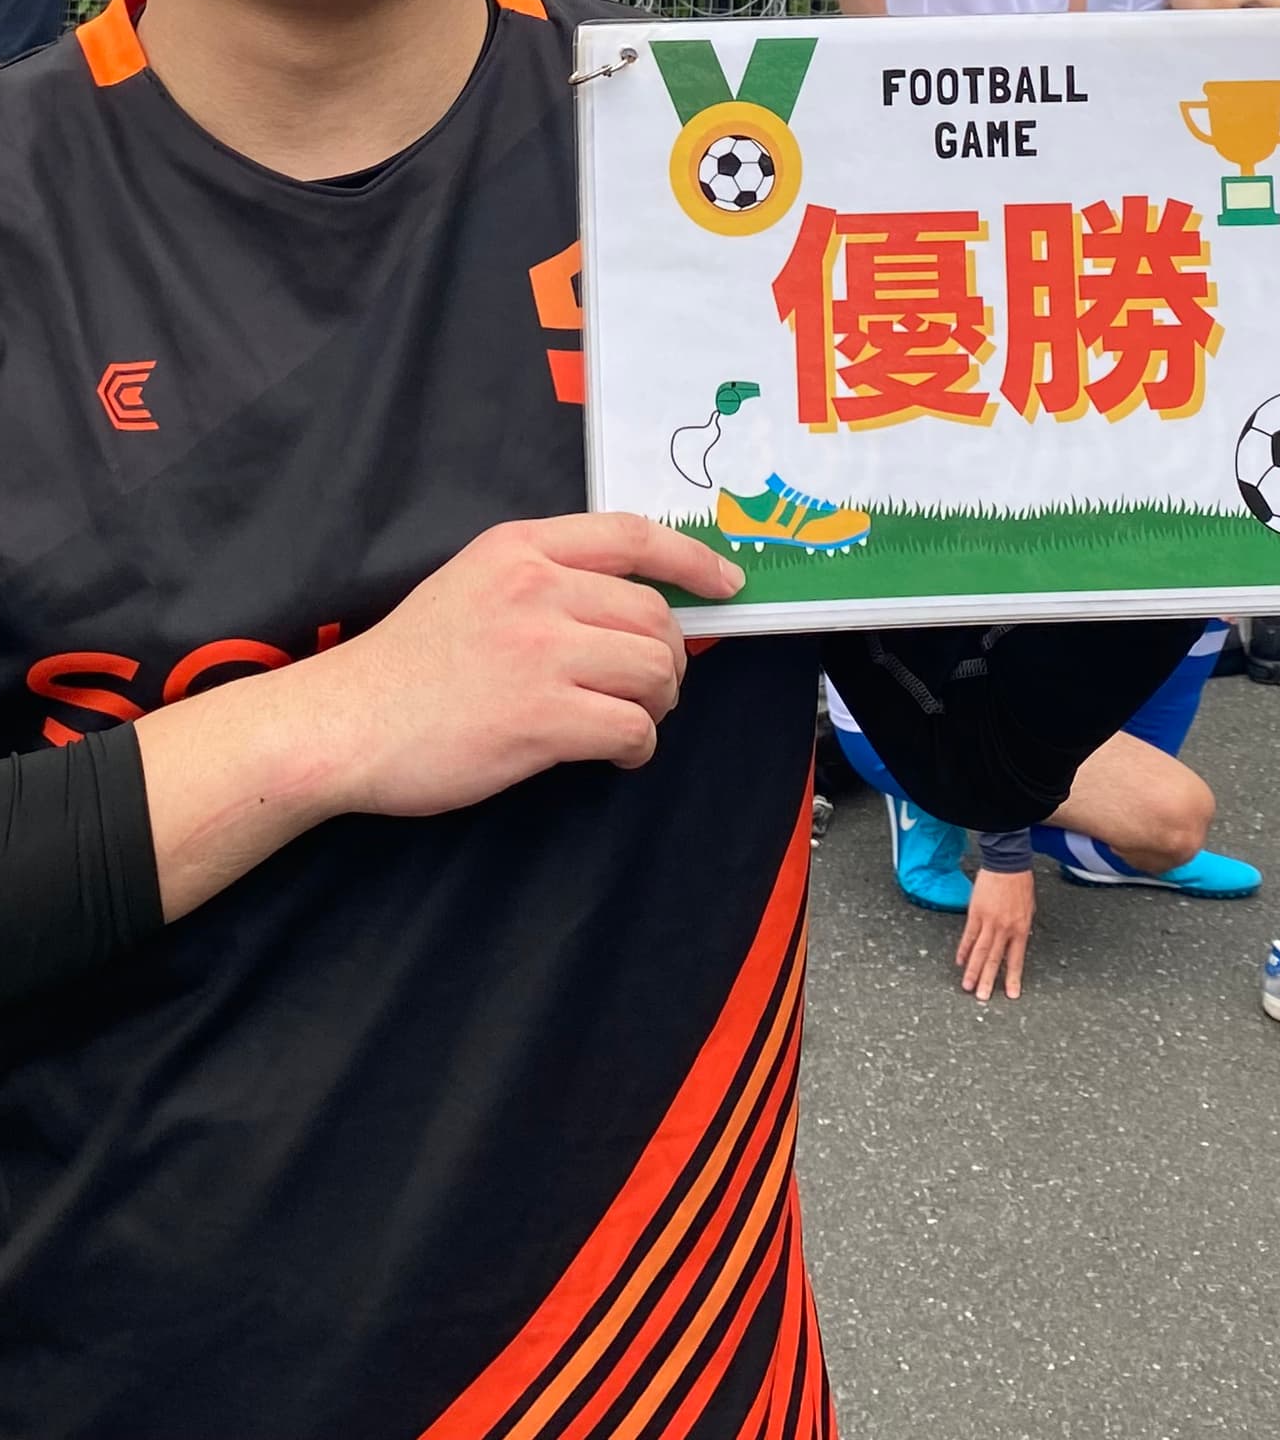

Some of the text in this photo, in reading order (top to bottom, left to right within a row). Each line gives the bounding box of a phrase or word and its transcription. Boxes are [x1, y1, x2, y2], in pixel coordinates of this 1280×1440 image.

[881, 64, 1089, 107] FOOTBALL
[932, 119, 1039, 160] GAME
[771, 194, 1224, 434] 優勝
